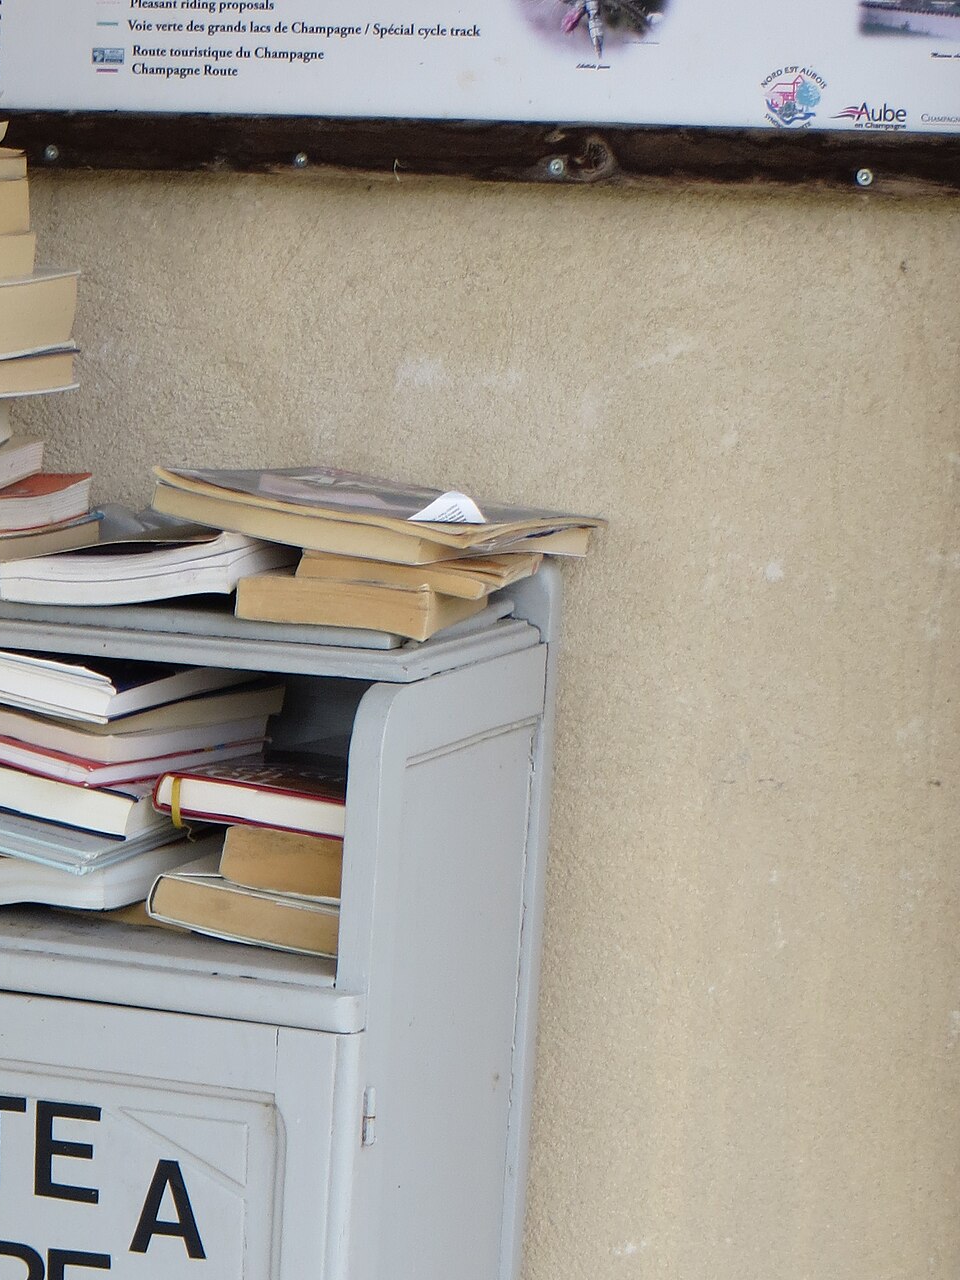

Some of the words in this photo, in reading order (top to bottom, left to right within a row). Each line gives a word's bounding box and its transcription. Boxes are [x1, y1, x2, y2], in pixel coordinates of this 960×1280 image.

[131, 0, 176, 8] Pleasant
[181, 0, 216, 13] riding
[219, 0, 274, 13] proposals
[128, 20, 152, 31] Voie
[156, 23, 183, 31] verte
[186, 20, 204, 31] des
[208, 21, 246, 36] grands
[250, 21, 270, 32] lacs
[274, 22, 287, 33] de
[292, 22, 361, 38] Champagne
[373, 23, 414, 39] Spécial
[418, 24, 446, 39] cycle
[451, 25, 480, 36] track
[133, 45, 166, 56] Route
[170, 47, 232, 61] touristique
[236, 47, 250, 58] du
[255, 47, 324, 63] Champagne
[132, 63, 200, 79] Champagne
[204, 65, 237, 76] Route
[855, 102, 907, 122] Aube
[864, 122, 907, 130] Champagne
[127, 1158, 208, 1260] A
